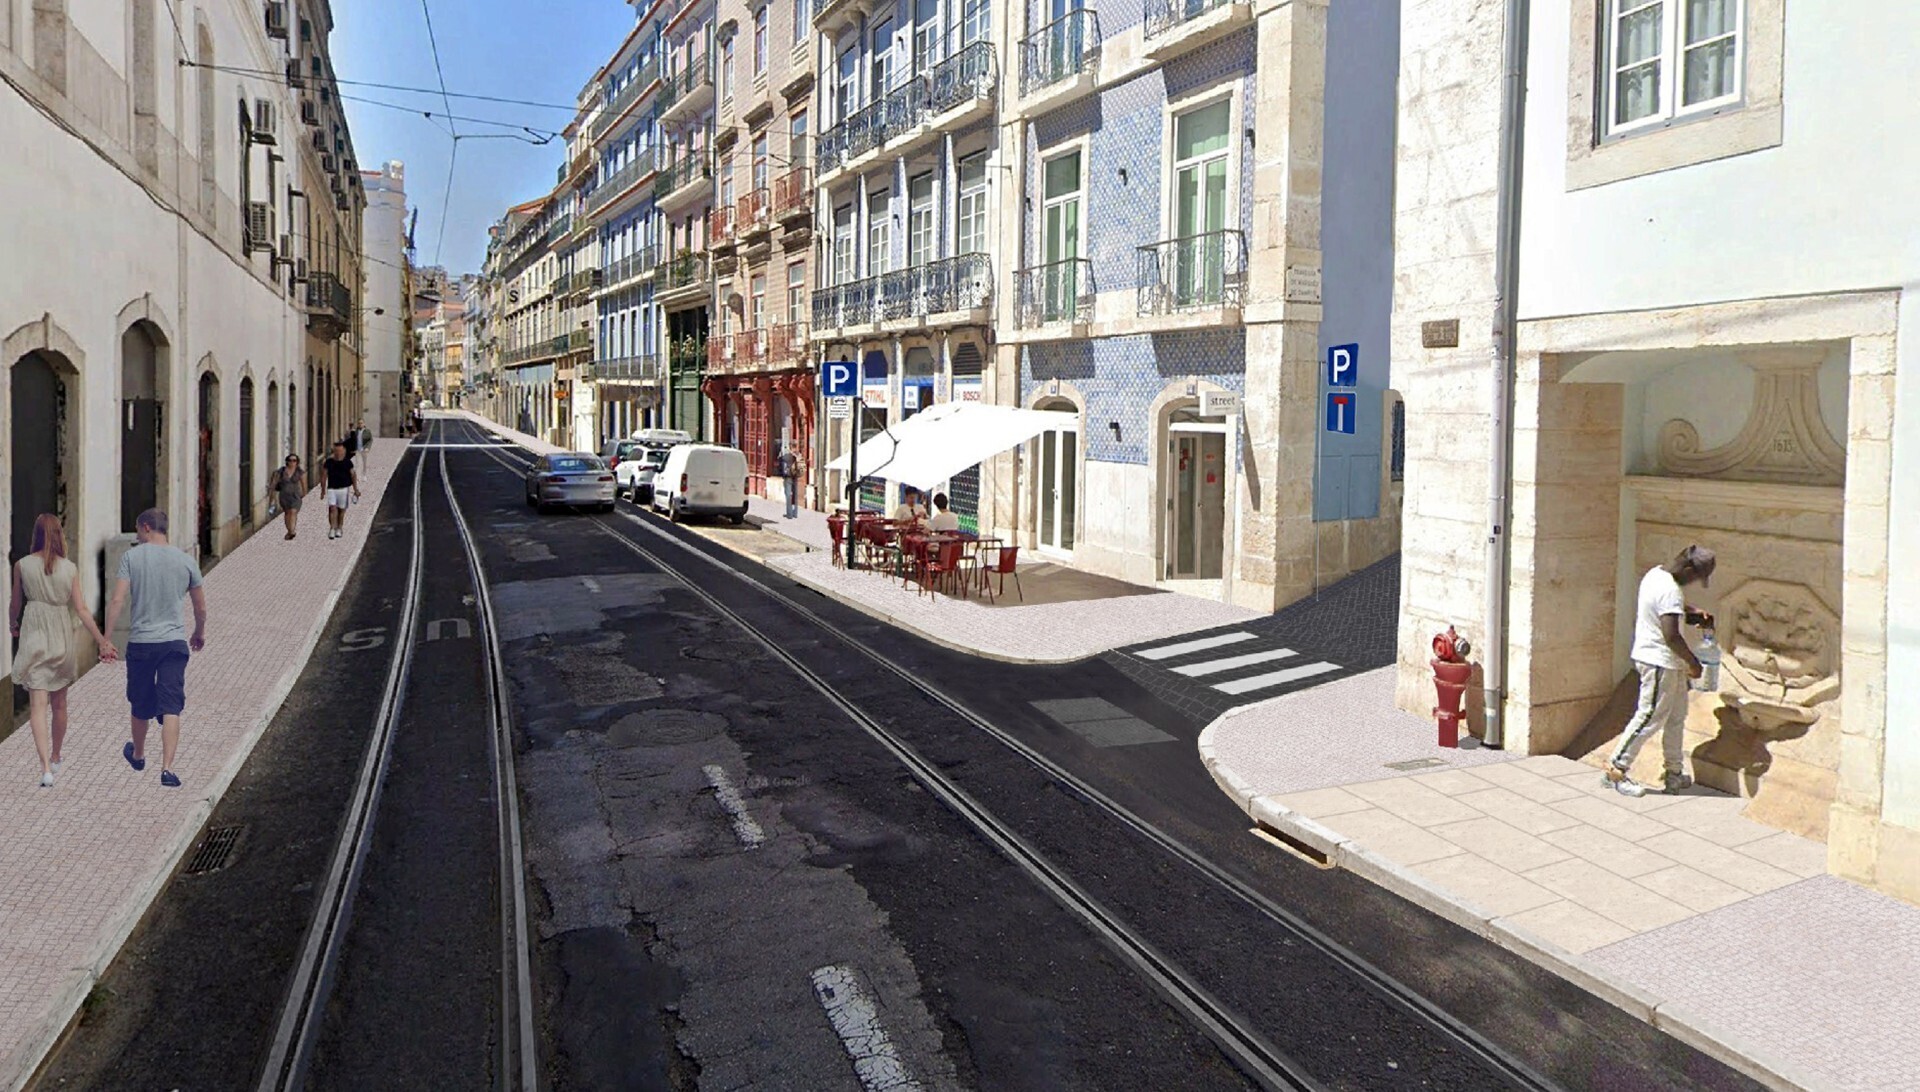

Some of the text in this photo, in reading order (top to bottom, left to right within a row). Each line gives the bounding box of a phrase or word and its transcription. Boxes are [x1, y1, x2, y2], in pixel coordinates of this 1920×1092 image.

[510, 290, 519, 302] S
[1333, 349, 1351, 382] P
[829, 365, 850, 393] P
[1210, 396, 1235, 406] street
